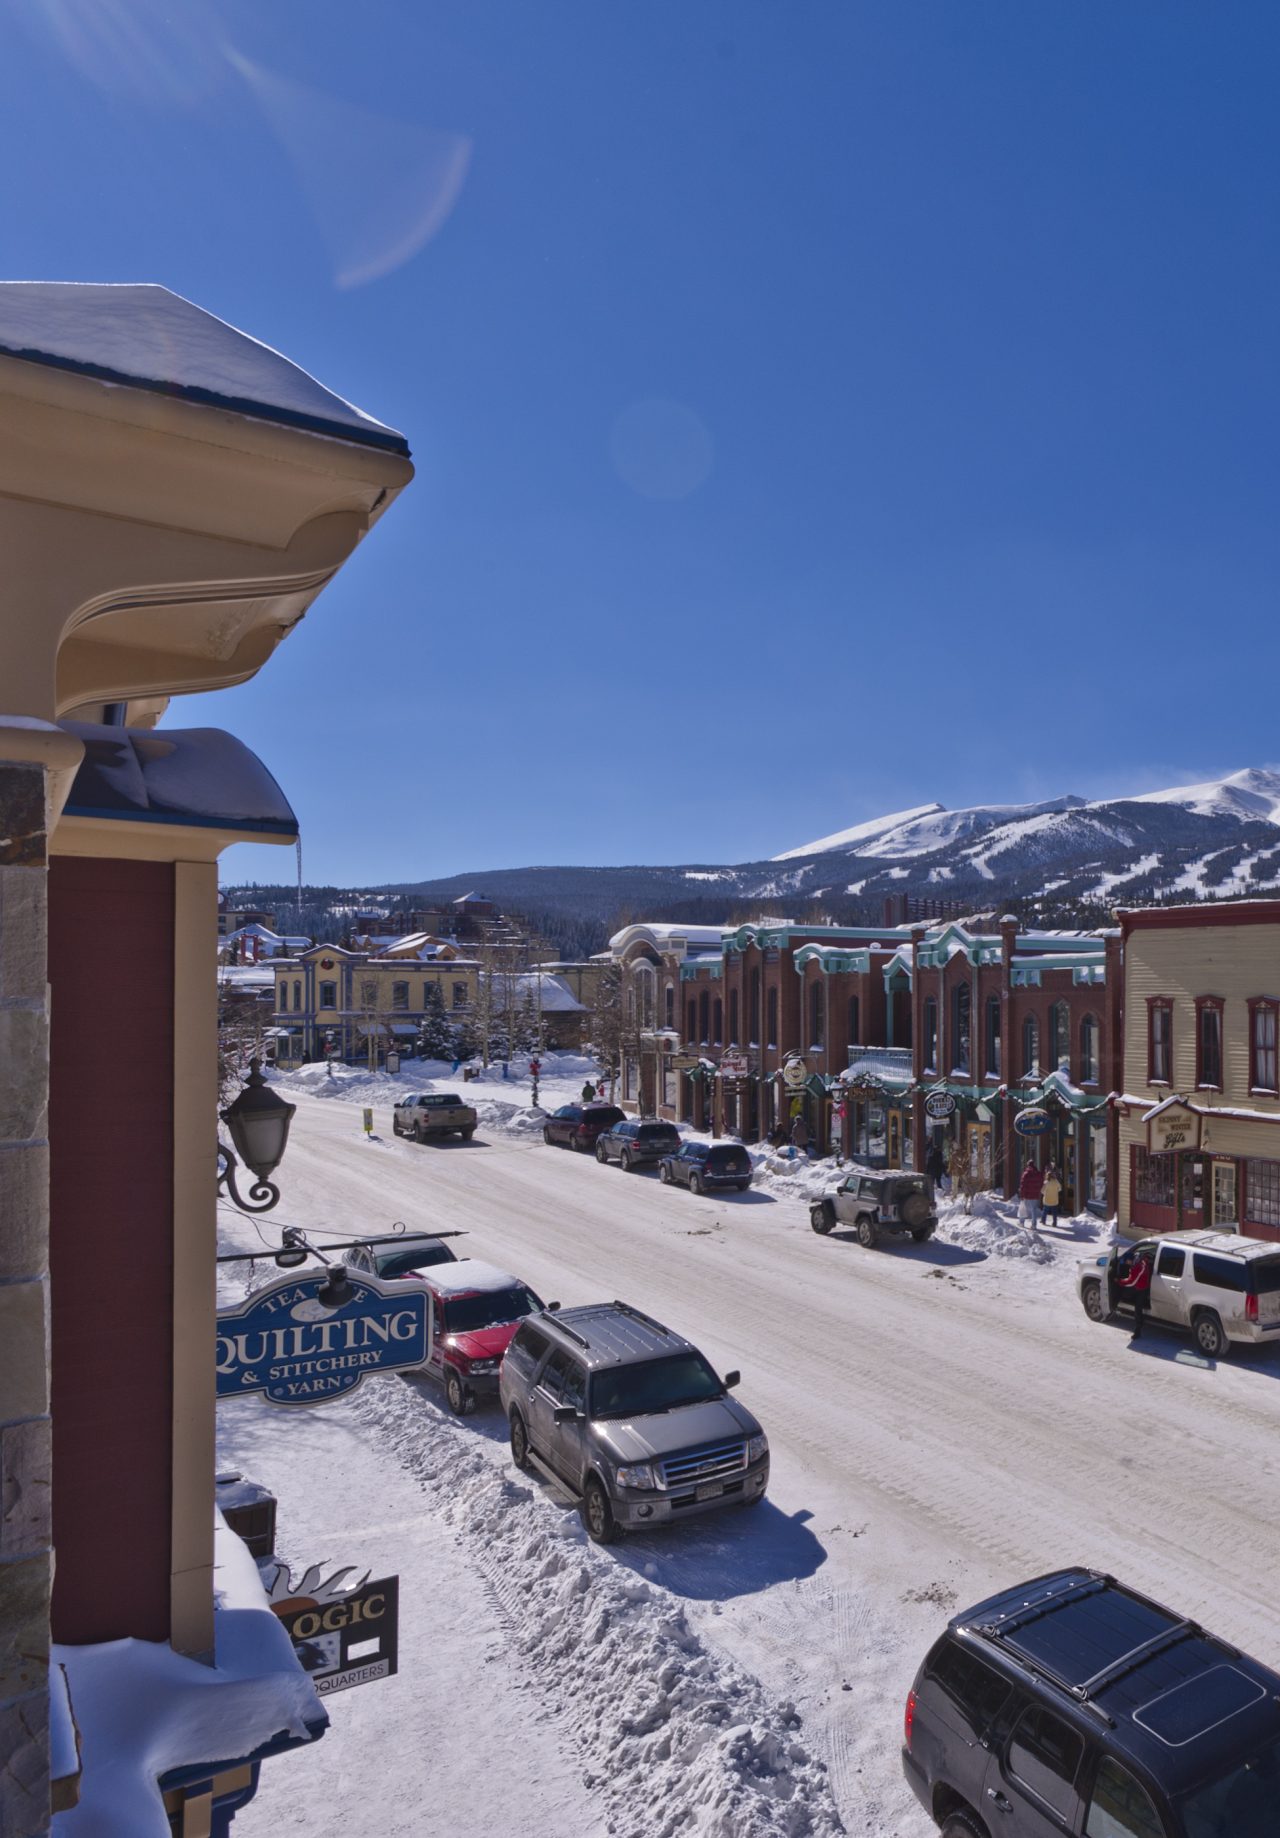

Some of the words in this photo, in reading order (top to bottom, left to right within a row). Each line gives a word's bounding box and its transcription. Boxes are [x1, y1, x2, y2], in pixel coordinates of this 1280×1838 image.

[261, 1288, 308, 1314] TEA
[216, 1310, 418, 1374] QUILTING
[241, 1371, 260, 1384] &
[269, 1350, 383, 1380] STITCHERY
[287, 1376, 342, 1396] YARN
[289, 1594, 386, 1637] OGIC
